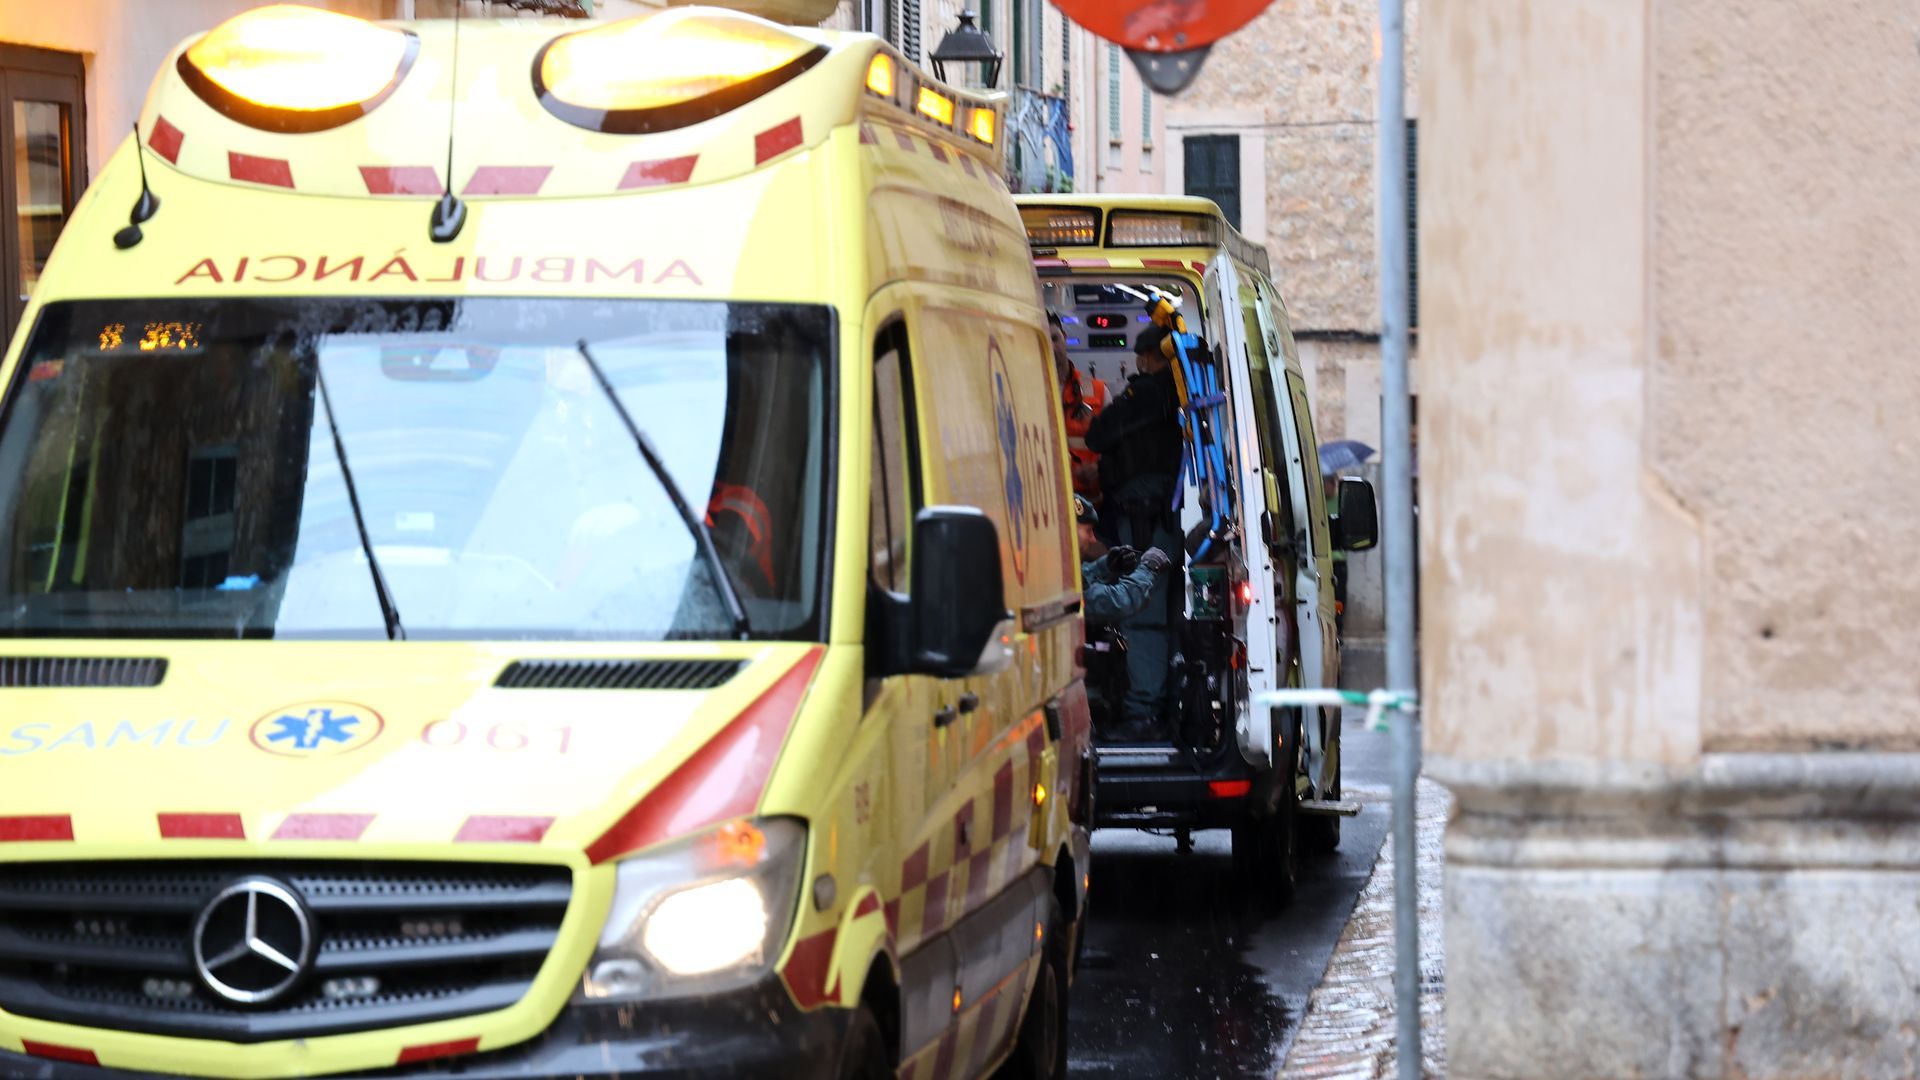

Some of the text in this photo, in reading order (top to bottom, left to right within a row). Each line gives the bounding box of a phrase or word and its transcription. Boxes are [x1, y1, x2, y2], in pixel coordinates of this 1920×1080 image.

[1020, 422, 1056, 530] 061
[0, 718, 573, 755] SAMU 061
